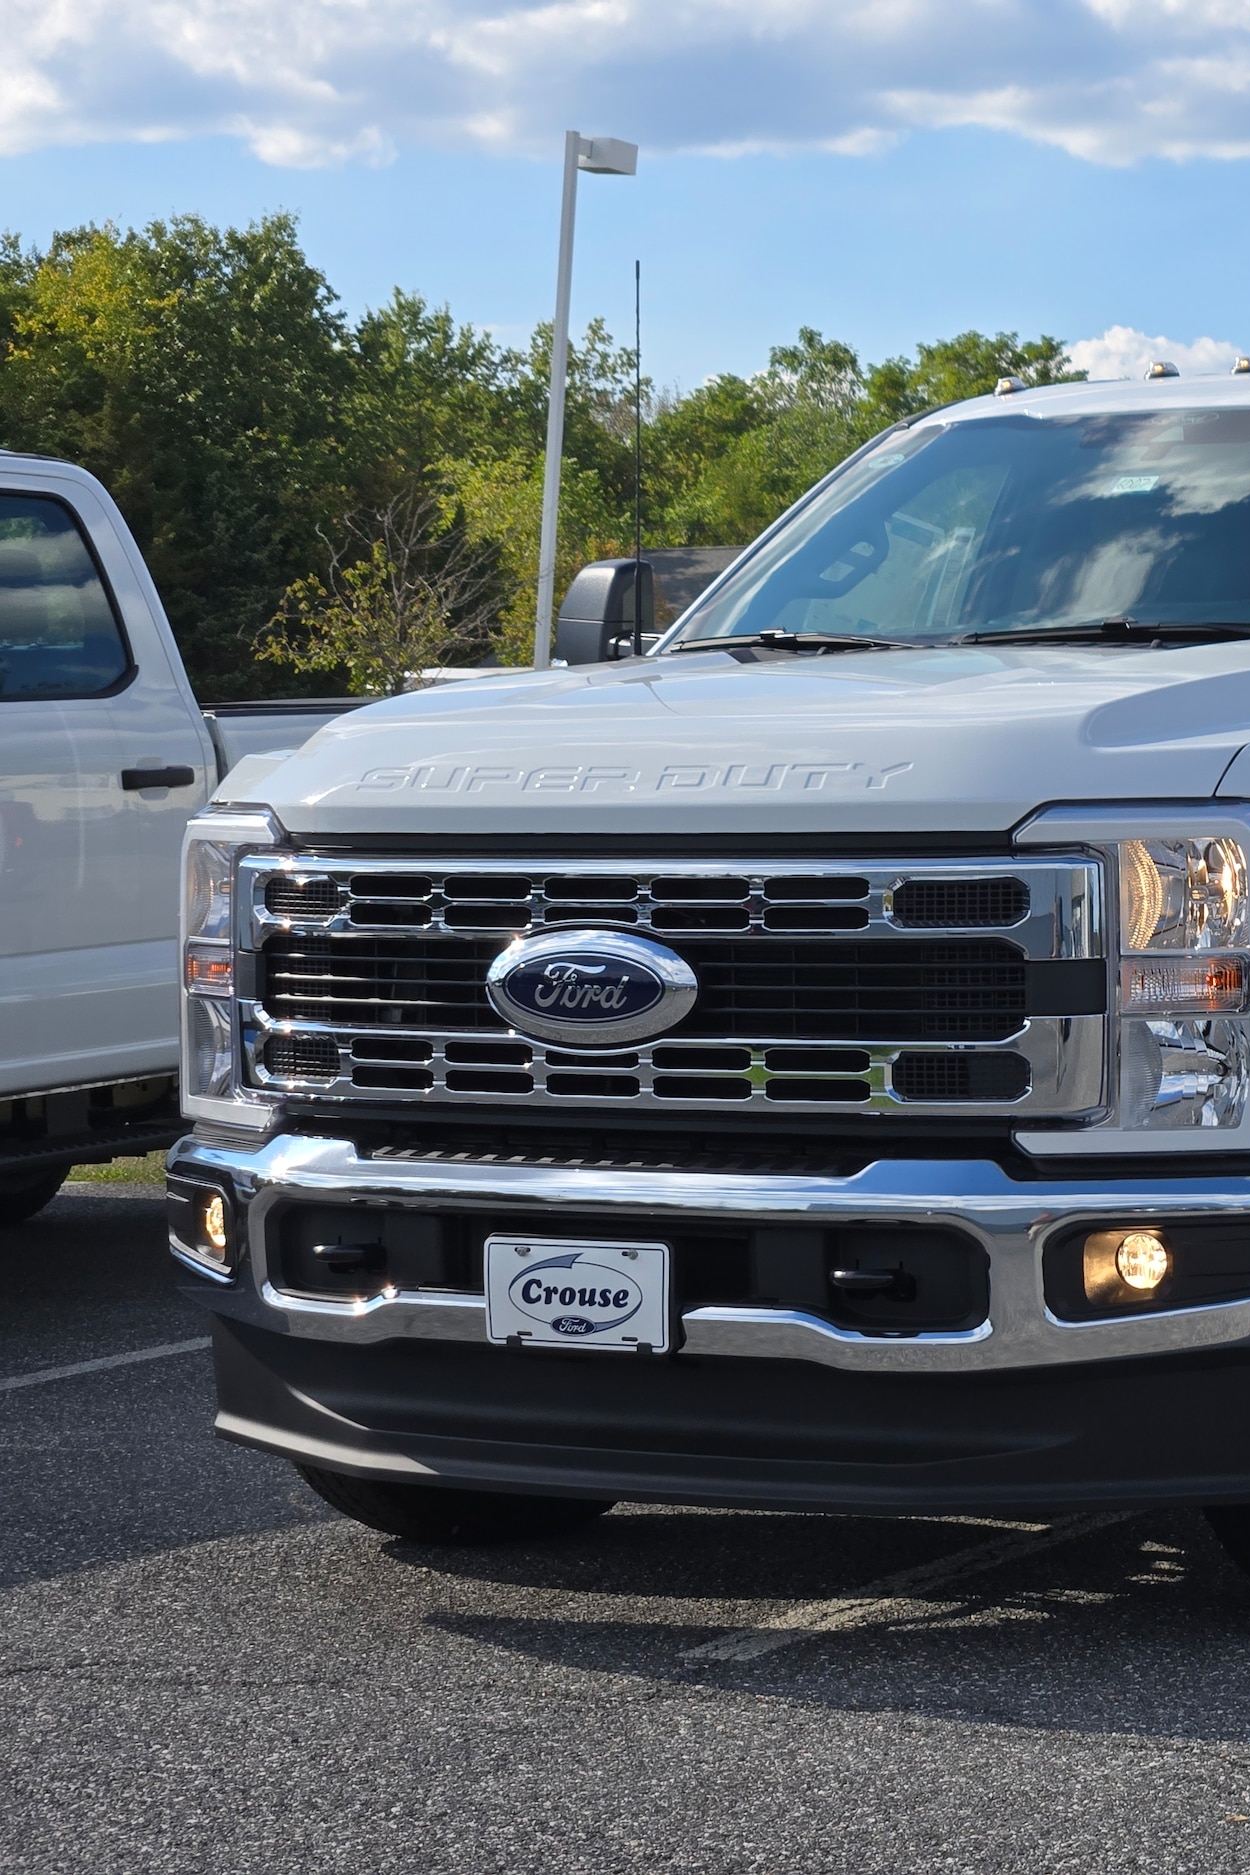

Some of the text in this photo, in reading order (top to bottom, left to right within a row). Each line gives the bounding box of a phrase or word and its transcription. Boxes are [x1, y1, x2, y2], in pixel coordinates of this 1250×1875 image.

[355, 762, 914, 792] SUPER DUTY
[535, 962, 630, 1009] Ford
[521, 1278, 629, 1308] Crouse
[559, 1318, 587, 1333] Ford
